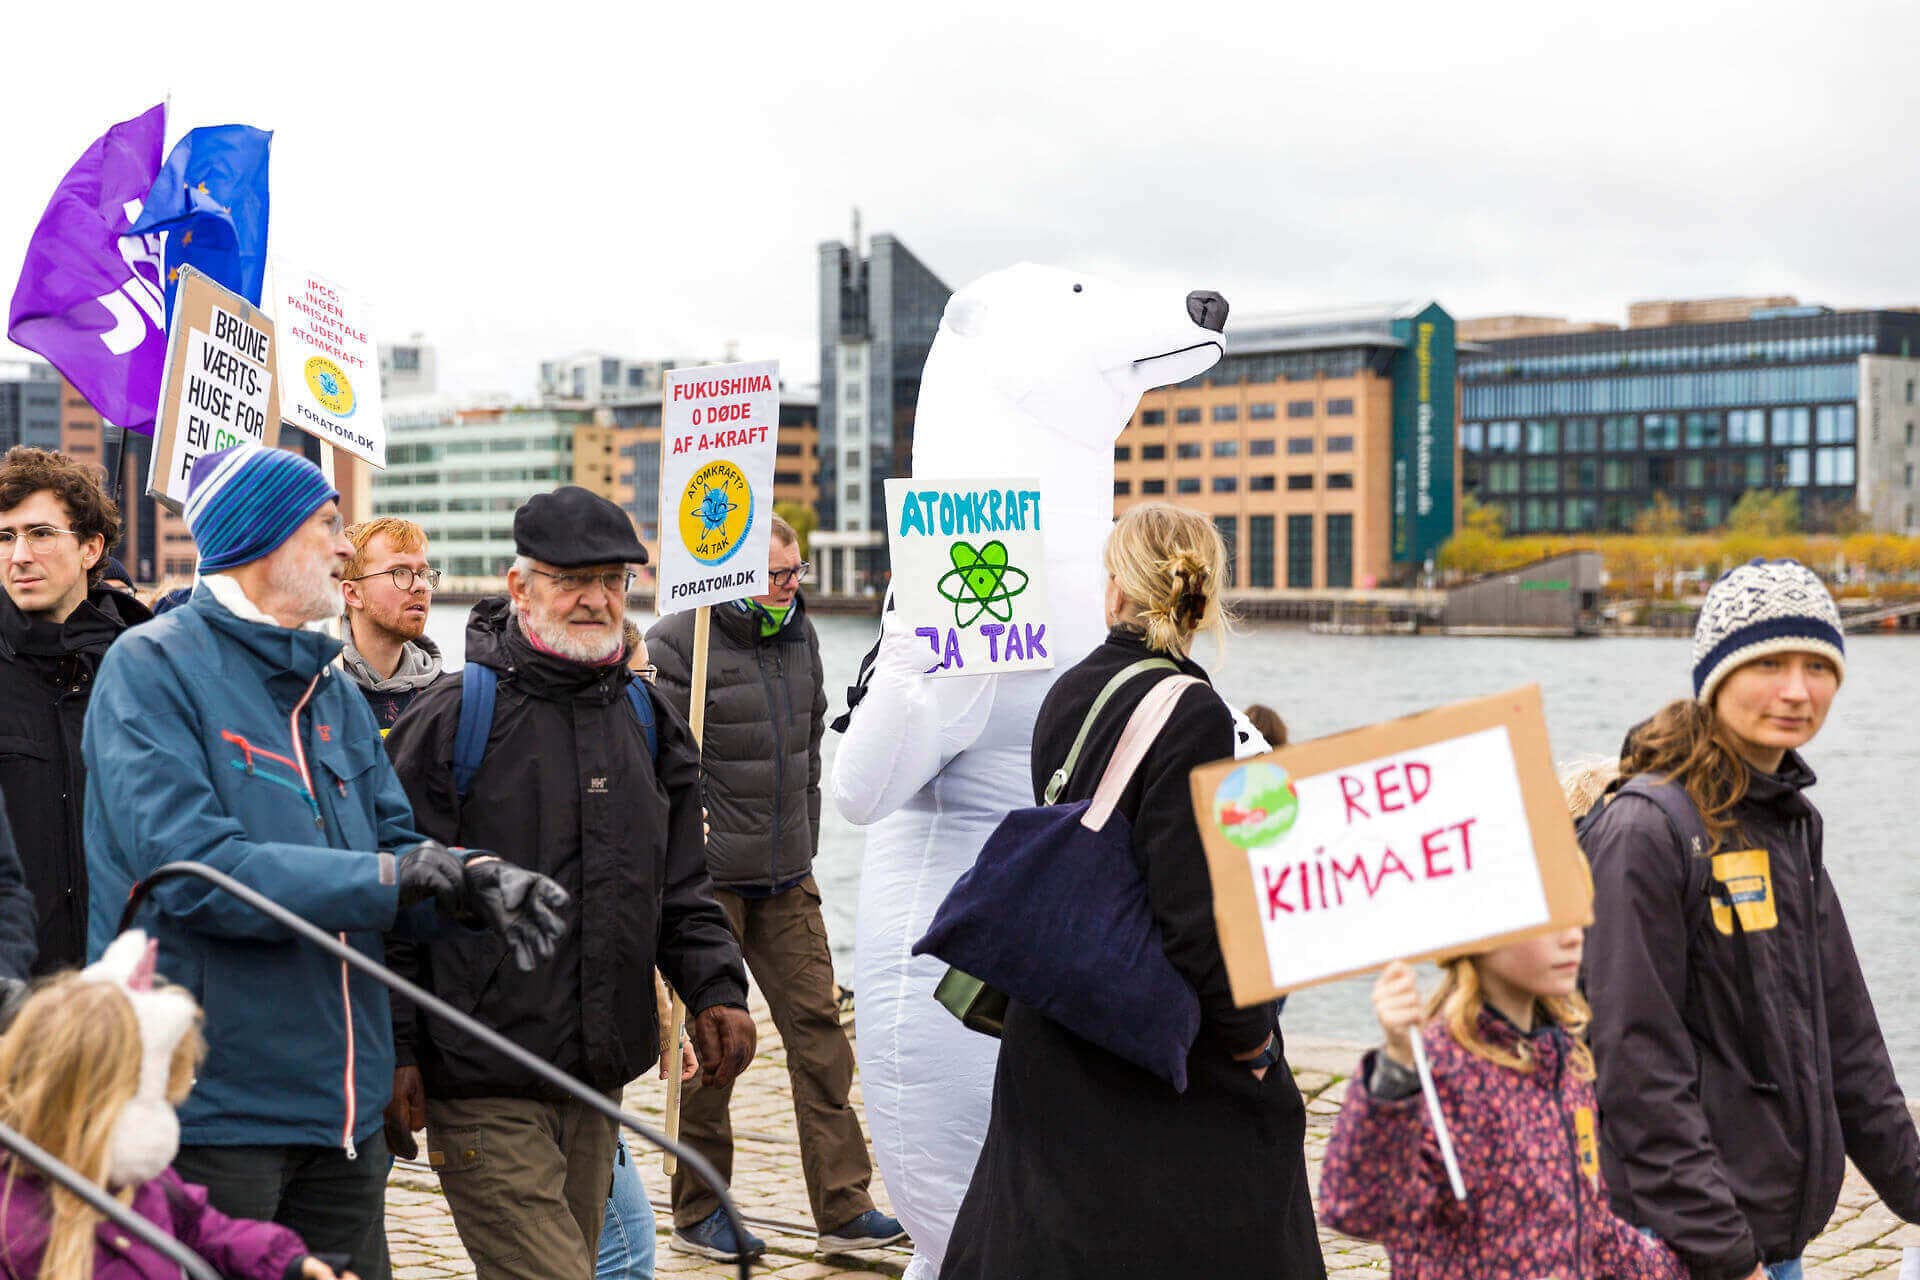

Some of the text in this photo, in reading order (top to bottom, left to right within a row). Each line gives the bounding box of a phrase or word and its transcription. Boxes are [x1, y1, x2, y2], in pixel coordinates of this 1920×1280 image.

[287, 295, 368, 344] PARISAFTALE
[305, 292, 343, 318] INGEN
[215, 310, 267, 363] BRUNE
[292, 326, 365, 368] ATOMKRAFT
[310, 321, 343, 346] UDEN
[203, 341, 262, 396] VÆRTS-
[673, 375, 772, 402] FUKUSHIMA
[188, 375, 265, 440] HUSE FOR
[708, 403, 751, 423] DØDE
[187, 415, 210, 450] EN
[297, 404, 375, 451] FORATOM.DK
[673, 427, 769, 455] AF A-KRAFT
[687, 464, 744, 500] ATOMKRAFT?
[900, 489, 1040, 537] ATOMKRAFT
[696, 536, 730, 557] JA TAK
[671, 569, 756, 599] FORATOM.DK
[980, 623, 1047, 662] TAK
[1338, 762, 1433, 824] RED
